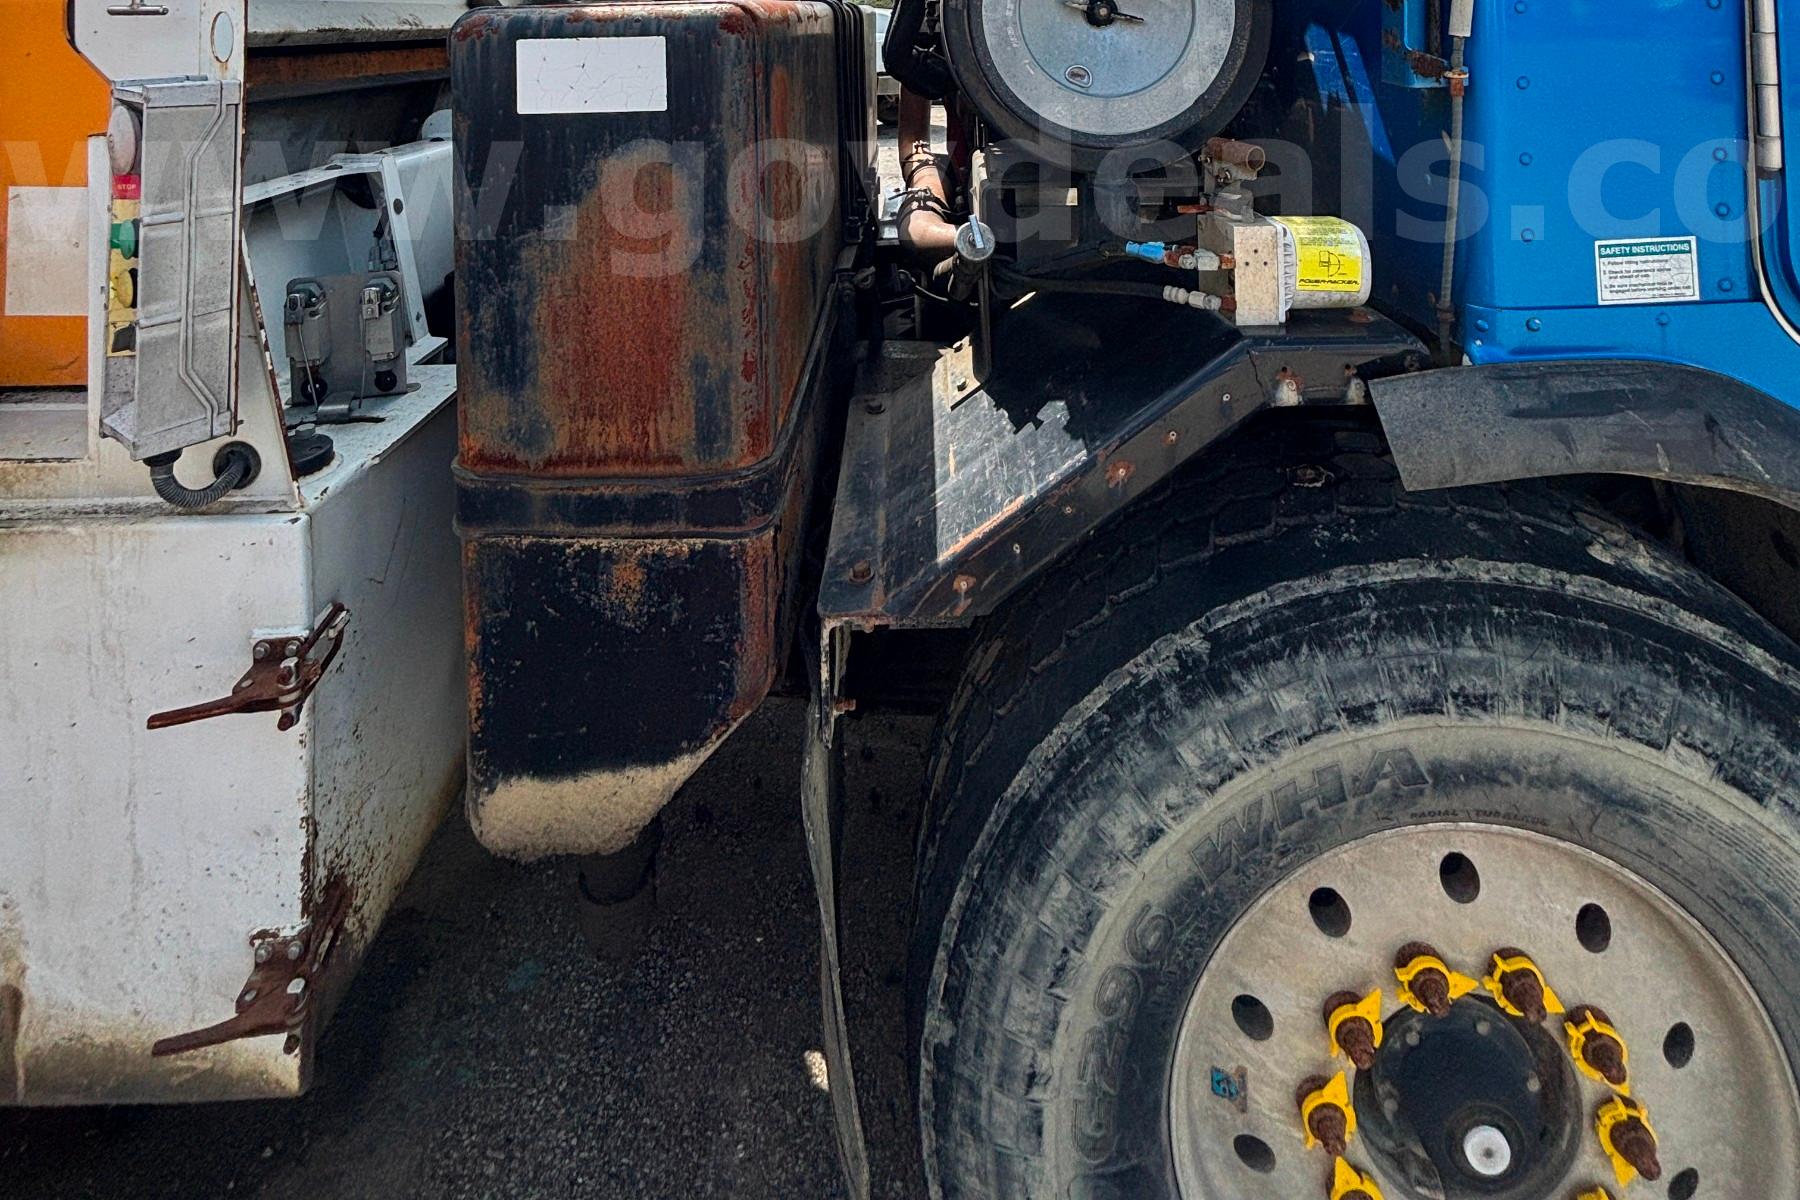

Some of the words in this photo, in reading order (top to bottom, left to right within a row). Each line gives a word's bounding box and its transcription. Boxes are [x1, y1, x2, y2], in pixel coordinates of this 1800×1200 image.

[1600, 246, 1630, 255] SAFETY
[1631, 243, 1690, 254] INSTRUCTIONS
[1410, 808, 1459, 820] RADIAL
[1190, 747, 1432, 894] WHA
